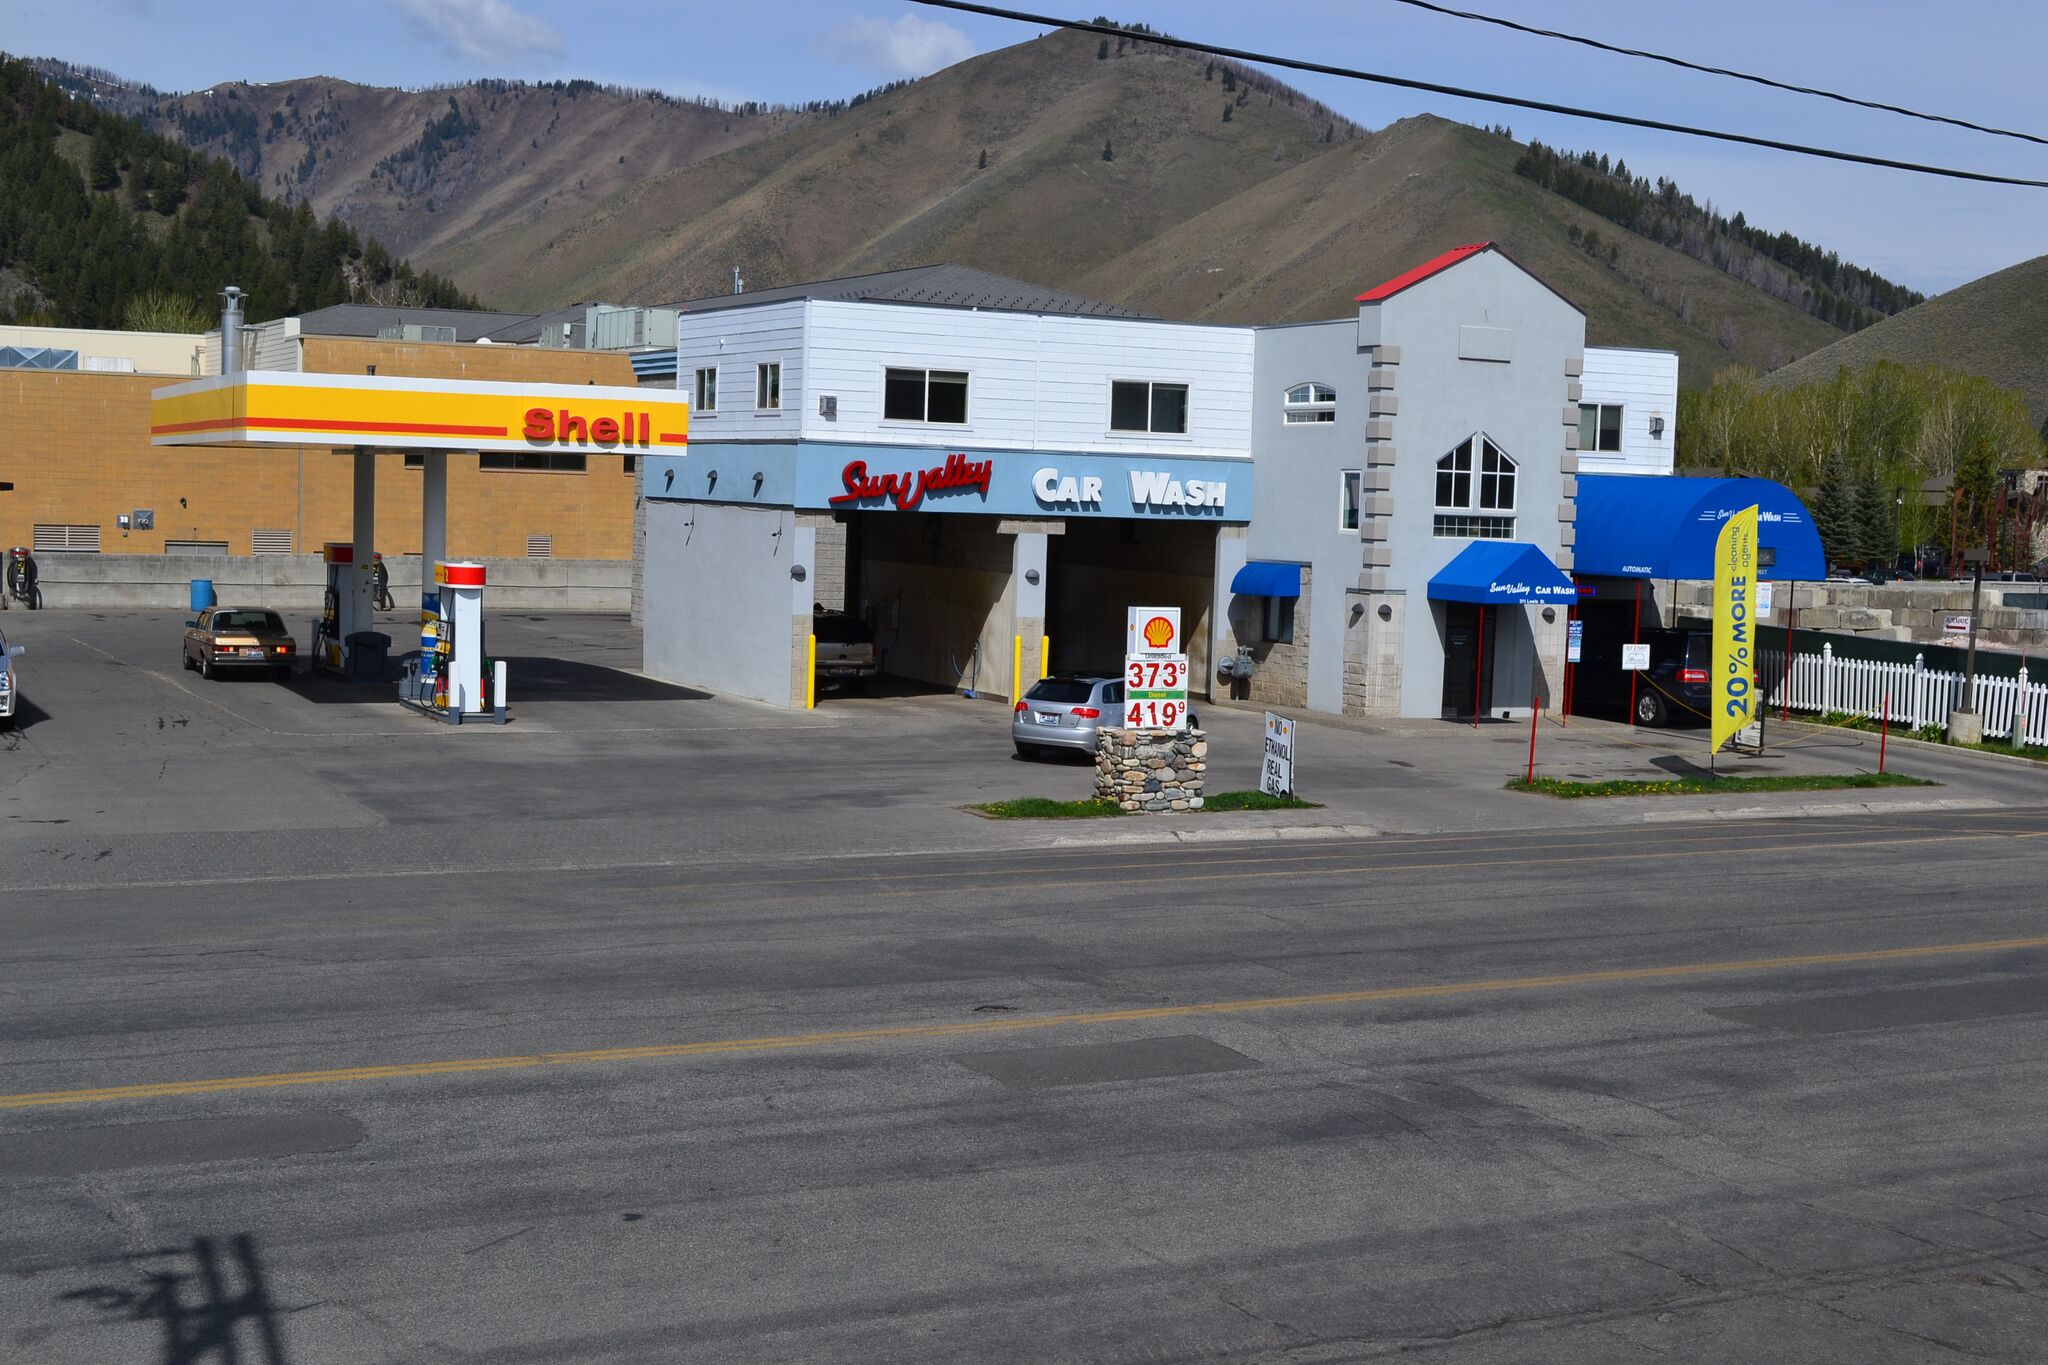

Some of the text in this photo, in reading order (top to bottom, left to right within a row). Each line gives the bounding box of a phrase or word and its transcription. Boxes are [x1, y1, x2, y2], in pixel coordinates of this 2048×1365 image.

[522, 408, 650, 443] Shell
[1031, 467, 1103, 503] CAR
[1127, 470, 1227, 507] WASH
[1728, 526, 1741, 571] cleaning
[1535, 586, 1551, 595] CAR
[1553, 586, 1576, 595] WASH
[1731, 575, 1747, 643] MORE
[1726, 647, 1749, 717] 20%
[1274, 718, 1283, 736] NO
[1264, 736, 1289, 761] ETHANOL
[1266, 758, 1282, 779] REAL
[1266, 776, 1280, 795] GAS
